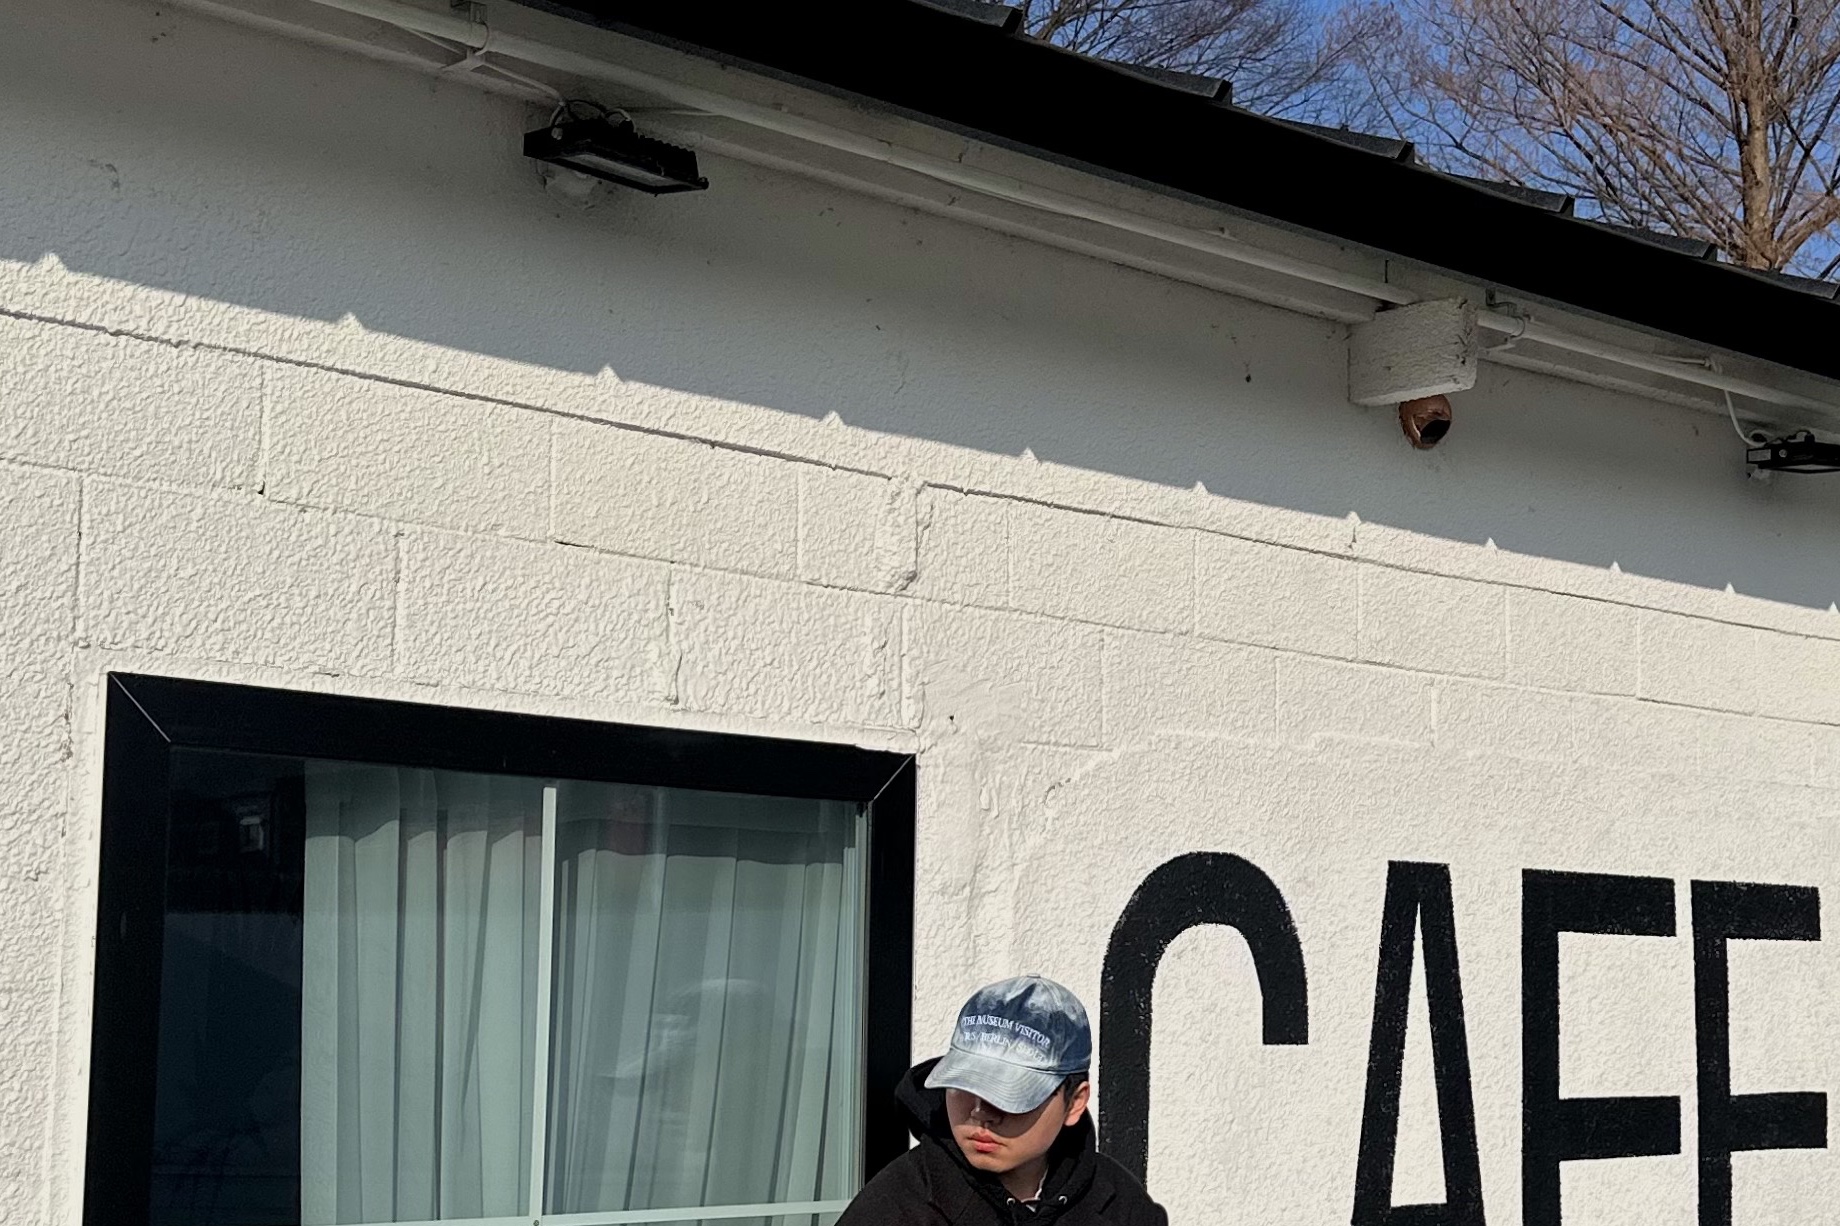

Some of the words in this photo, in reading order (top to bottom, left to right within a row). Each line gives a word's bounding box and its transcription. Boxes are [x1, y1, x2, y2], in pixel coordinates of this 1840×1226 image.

[962, 1015, 976, 1026] THE
[977, 1014, 1015, 1030] MUSEUM
[1015, 1022, 1051, 1048] VISITOR
[981, 1032, 1012, 1049] BERLIN
